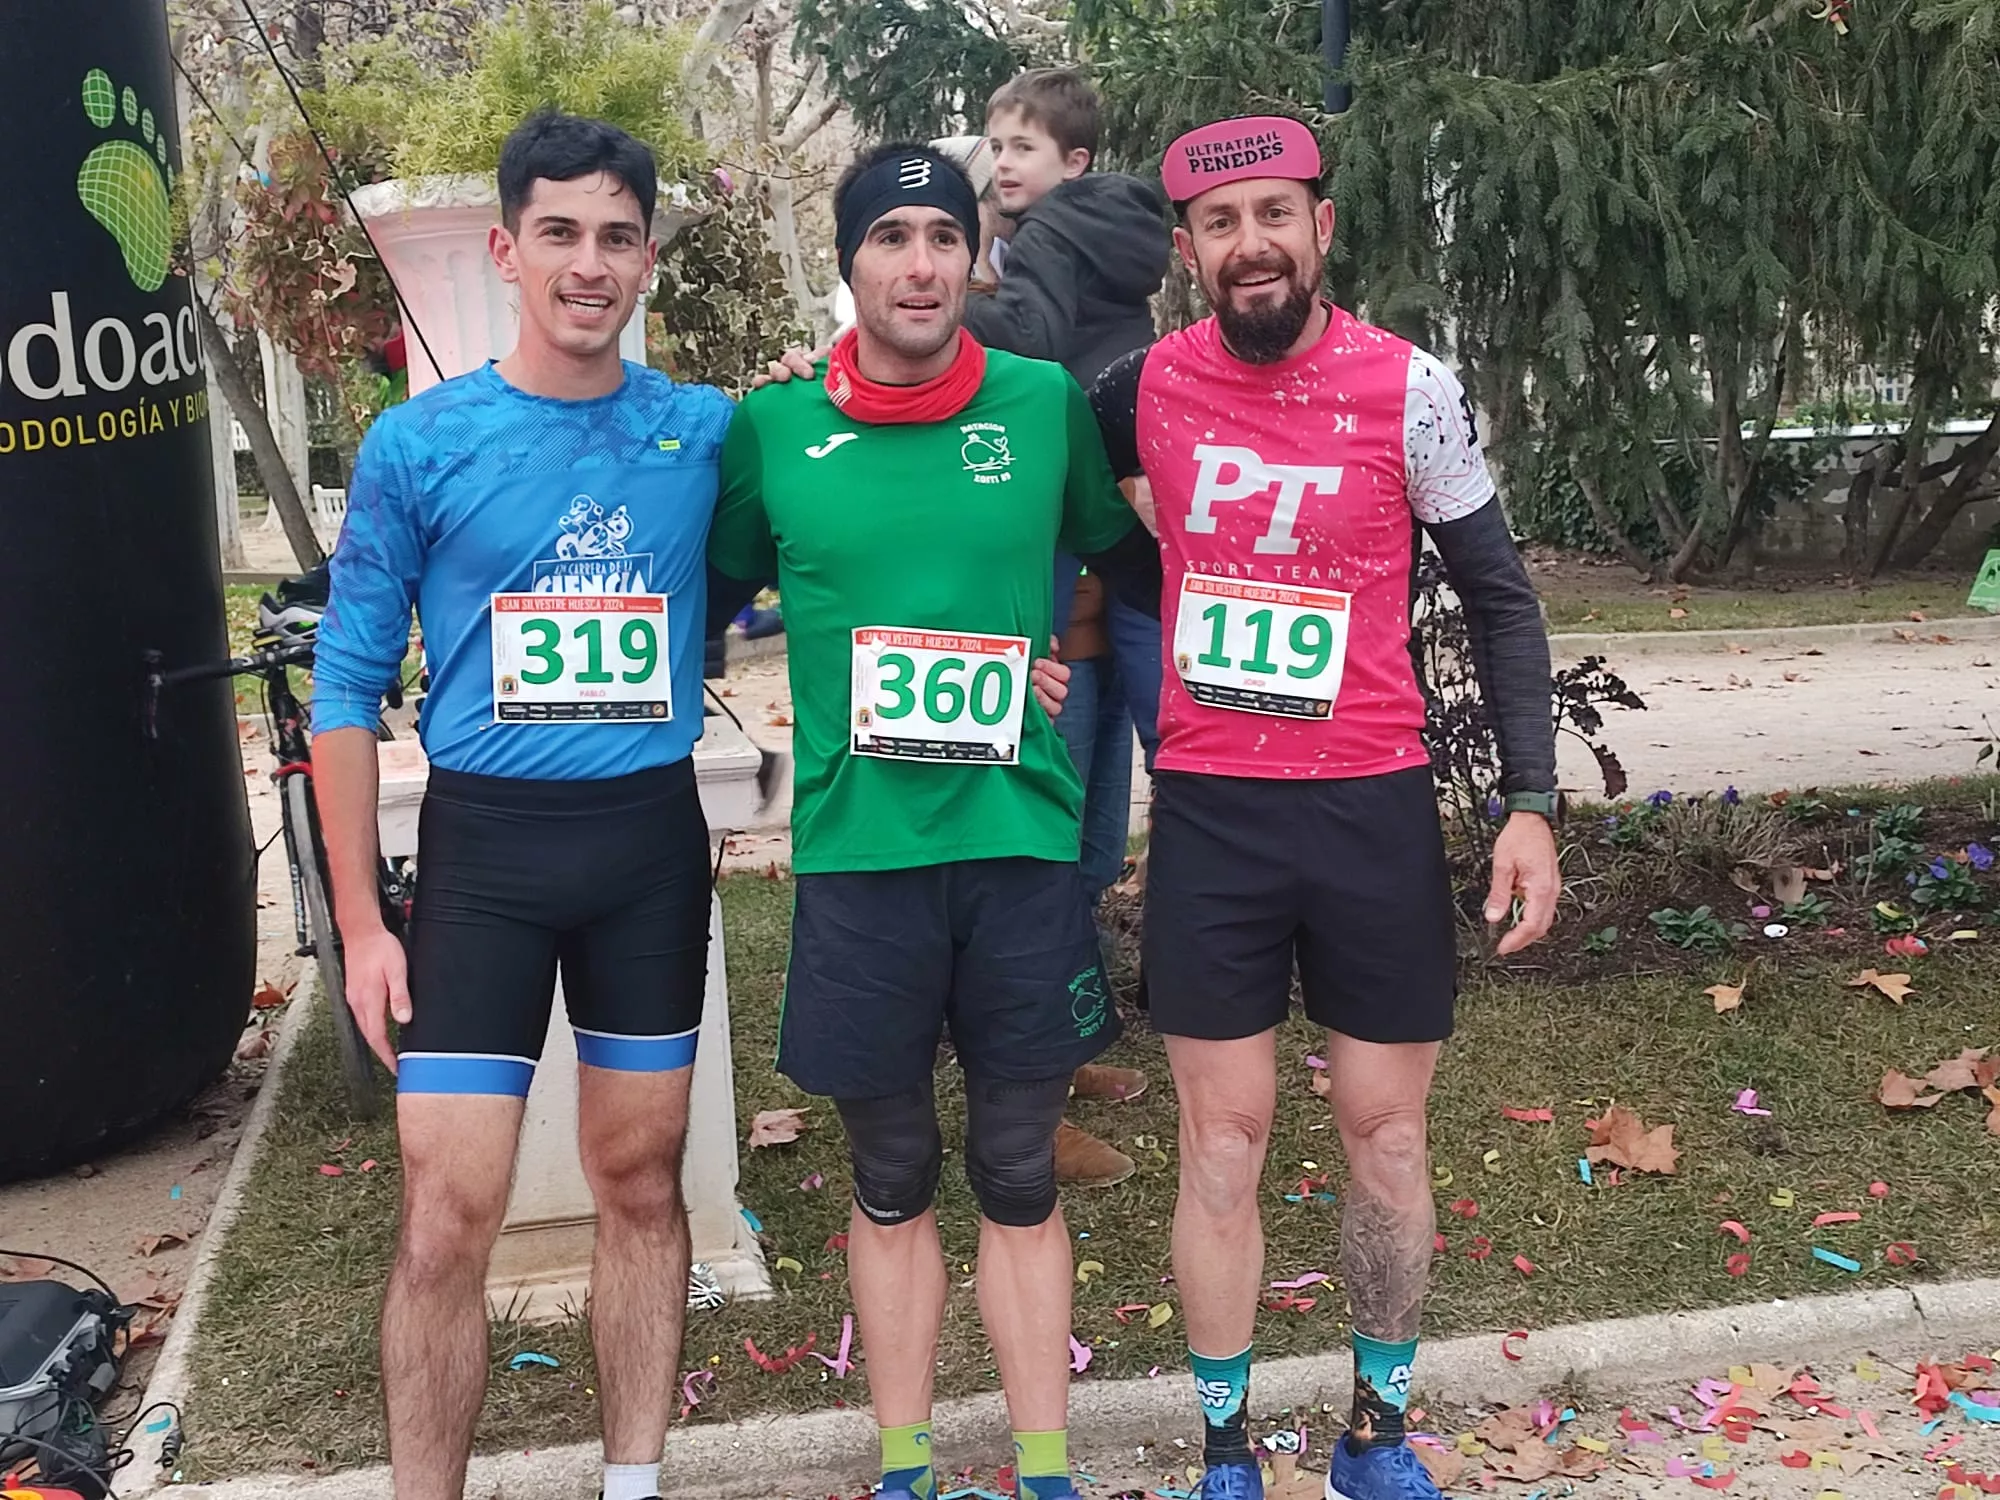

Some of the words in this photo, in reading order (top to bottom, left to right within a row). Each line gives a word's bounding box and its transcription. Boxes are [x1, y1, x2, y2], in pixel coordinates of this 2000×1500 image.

[1185, 131, 1281, 158] ULTRATRAIL
[1189, 142, 1284, 173] PENEDES
[169, 398, 181, 428] Y
[1184, 444, 1343, 555] PT
[568, 562, 607, 575] CARRERA
[609, 561, 621, 573] DE
[1185, 560, 1254, 577] SPORT
[1273, 565, 1341, 579] TEAM
[501, 598, 520, 610] SAN
[521, 598, 566, 611] SILVESTRE
[568, 598, 601, 611] HUESCA
[603, 598, 625, 611] 2024
[1204, 581, 1243, 598] SILVESTRE
[1243, 587, 1277, 600] HUESCA
[1277, 590, 1301, 604] 2024
[521, 618, 658, 685] 319
[880, 633, 923, 649] SILVESTRE
[925, 637, 959, 650] HUESCA
[960, 639, 982, 652] 2024
[1198, 603, 1333, 680] 119
[875, 653, 1012, 726] 360
